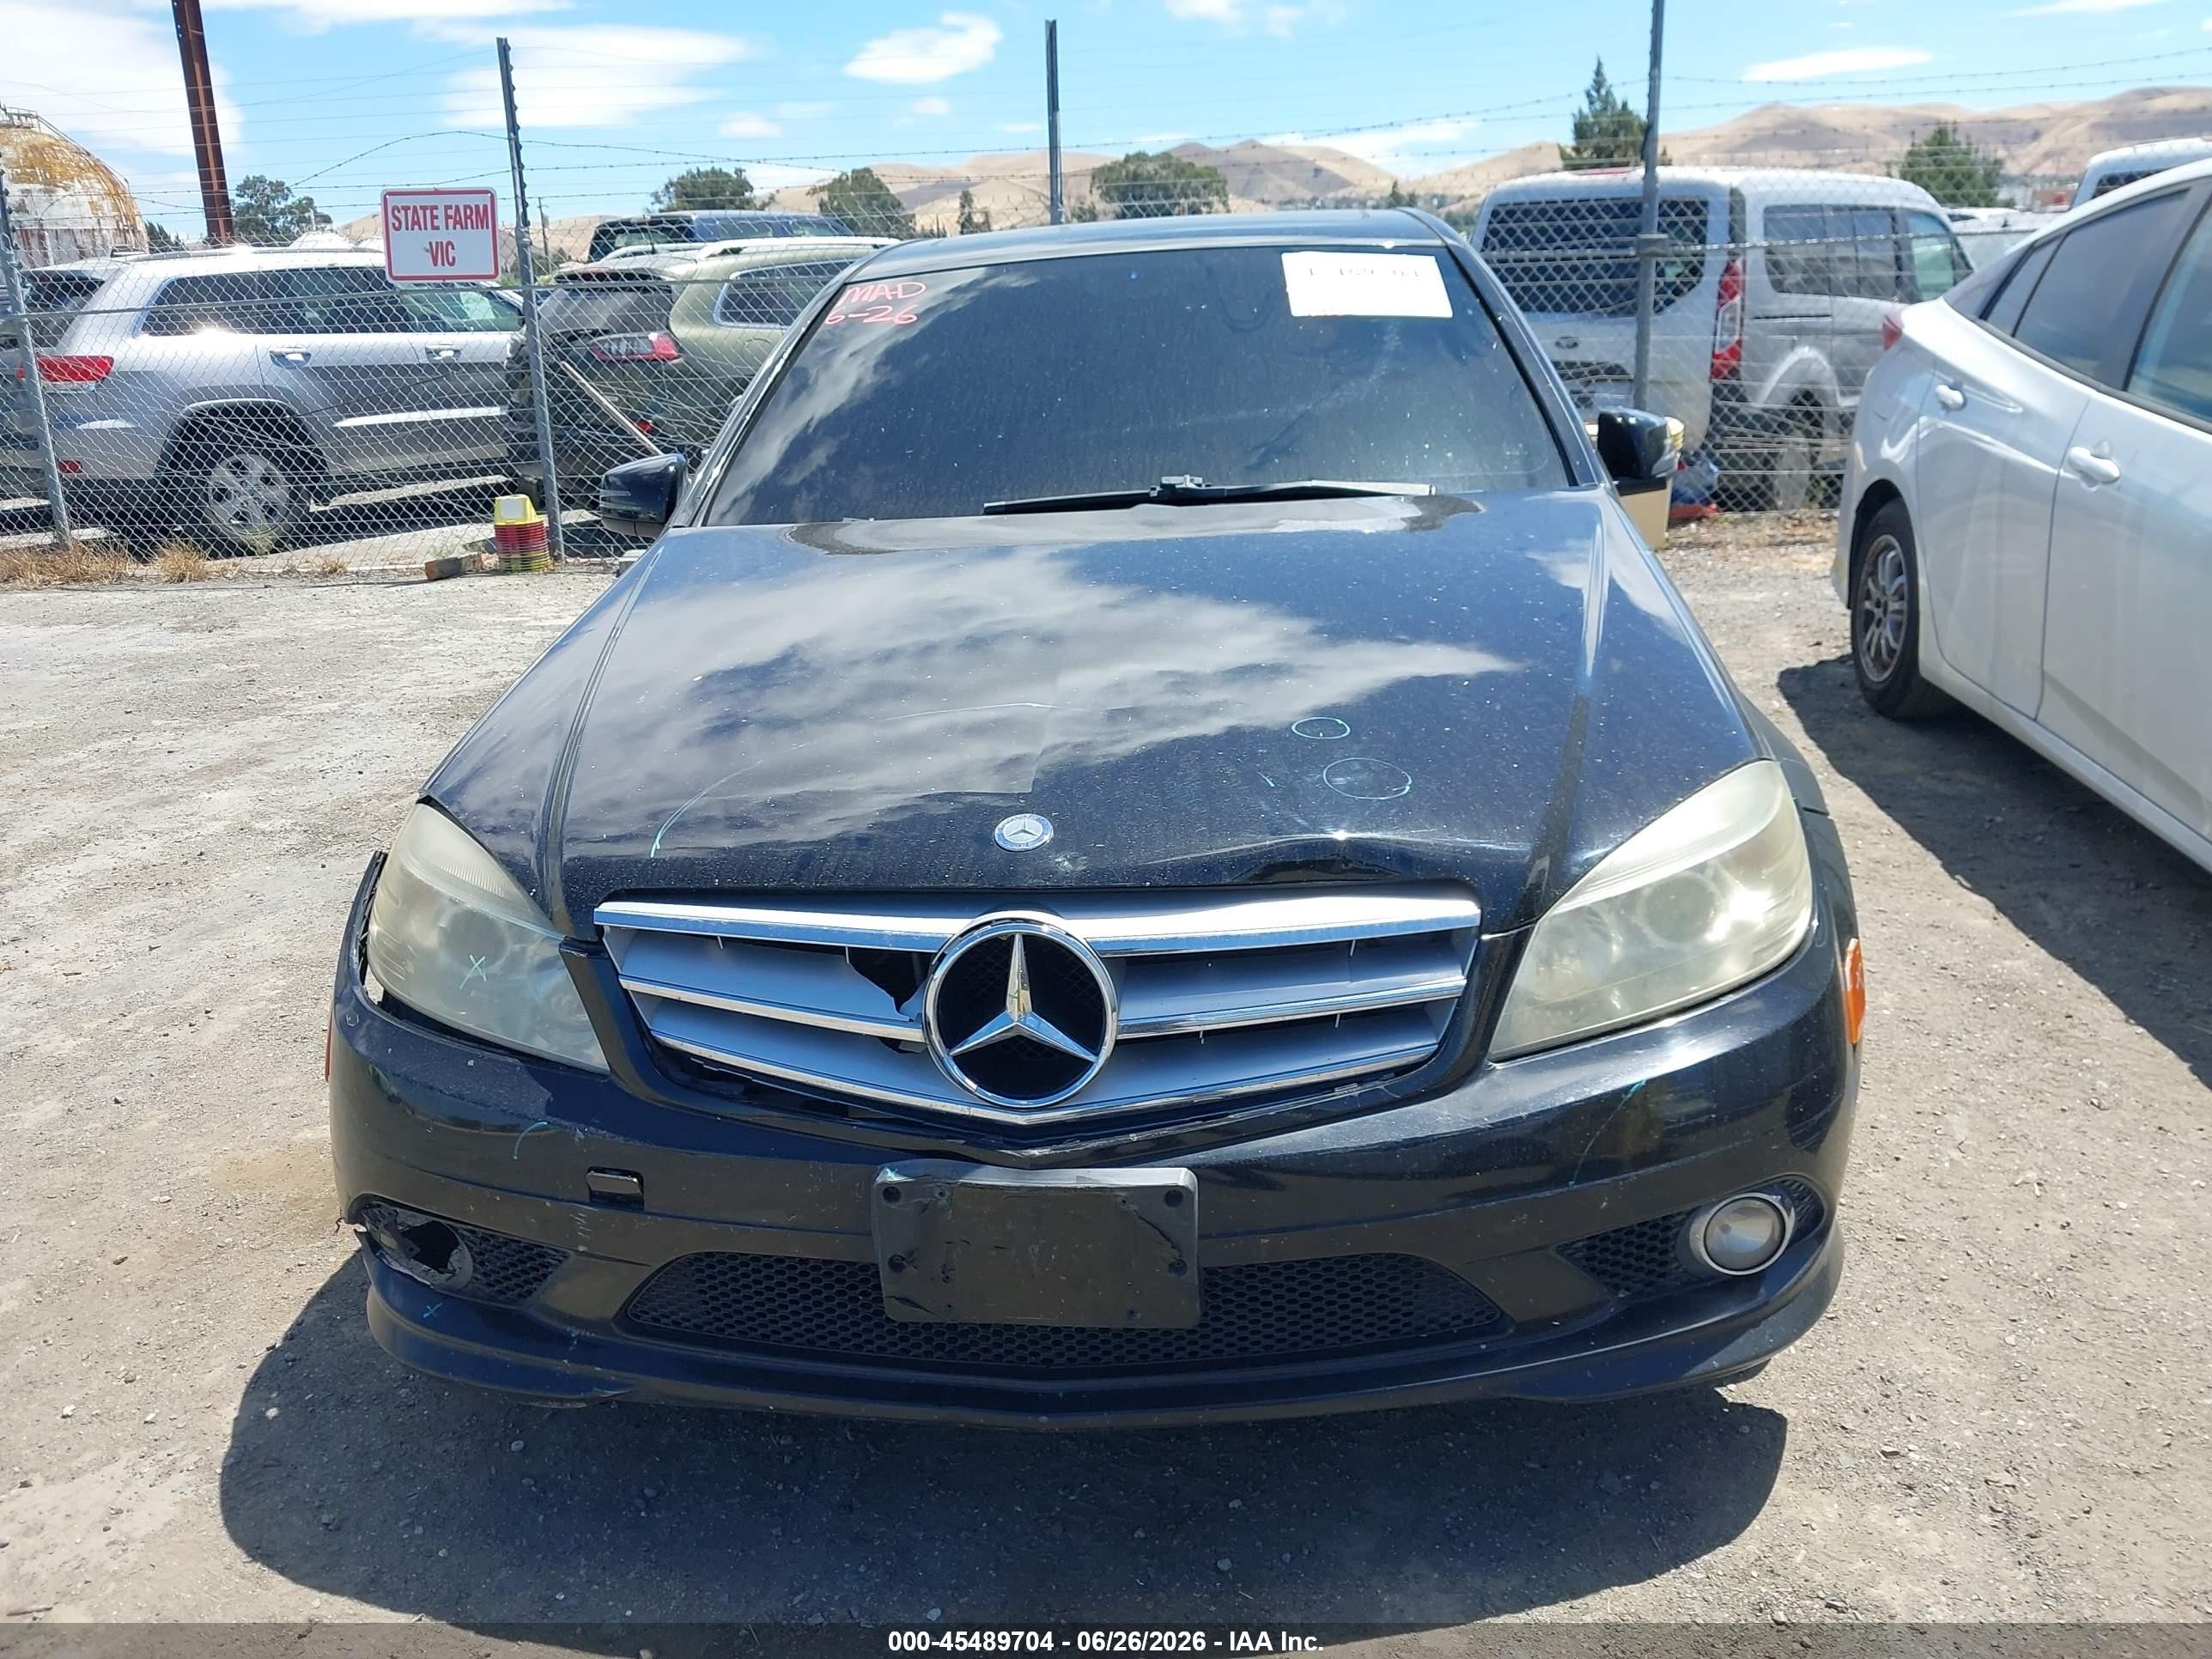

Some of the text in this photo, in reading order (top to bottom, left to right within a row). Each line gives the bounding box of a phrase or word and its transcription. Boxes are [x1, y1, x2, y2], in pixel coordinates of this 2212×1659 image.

[391, 204, 490, 232] STATE FARM
[428, 240, 456, 267] VIC
